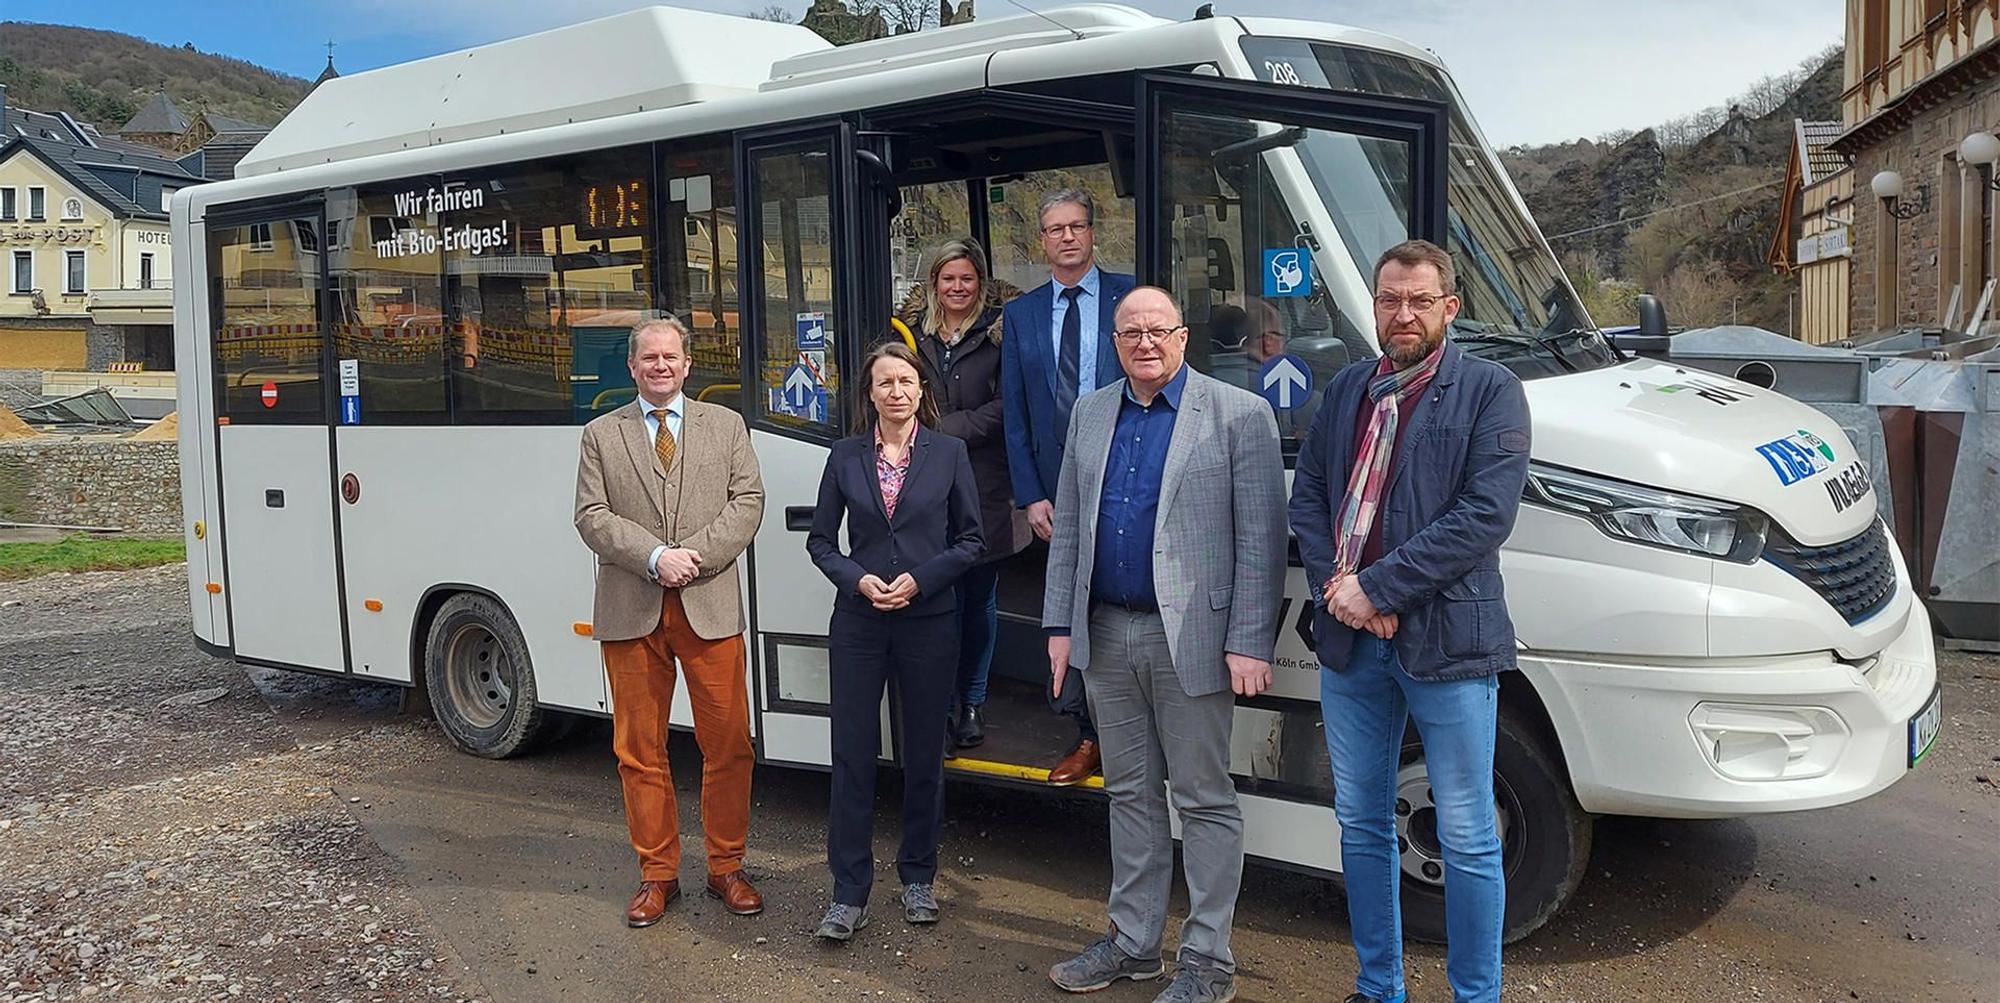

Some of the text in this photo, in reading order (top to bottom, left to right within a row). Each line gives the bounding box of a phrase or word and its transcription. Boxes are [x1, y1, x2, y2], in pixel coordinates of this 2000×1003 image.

[1264, 60, 1300, 85] 208
[394, 186, 483, 217] Wir fahren
[137, 230, 172, 245] HOTEL
[376, 219, 508, 259] mit Bio-Erdgas!
[1275, 656, 1320, 671] Köln Gmb
